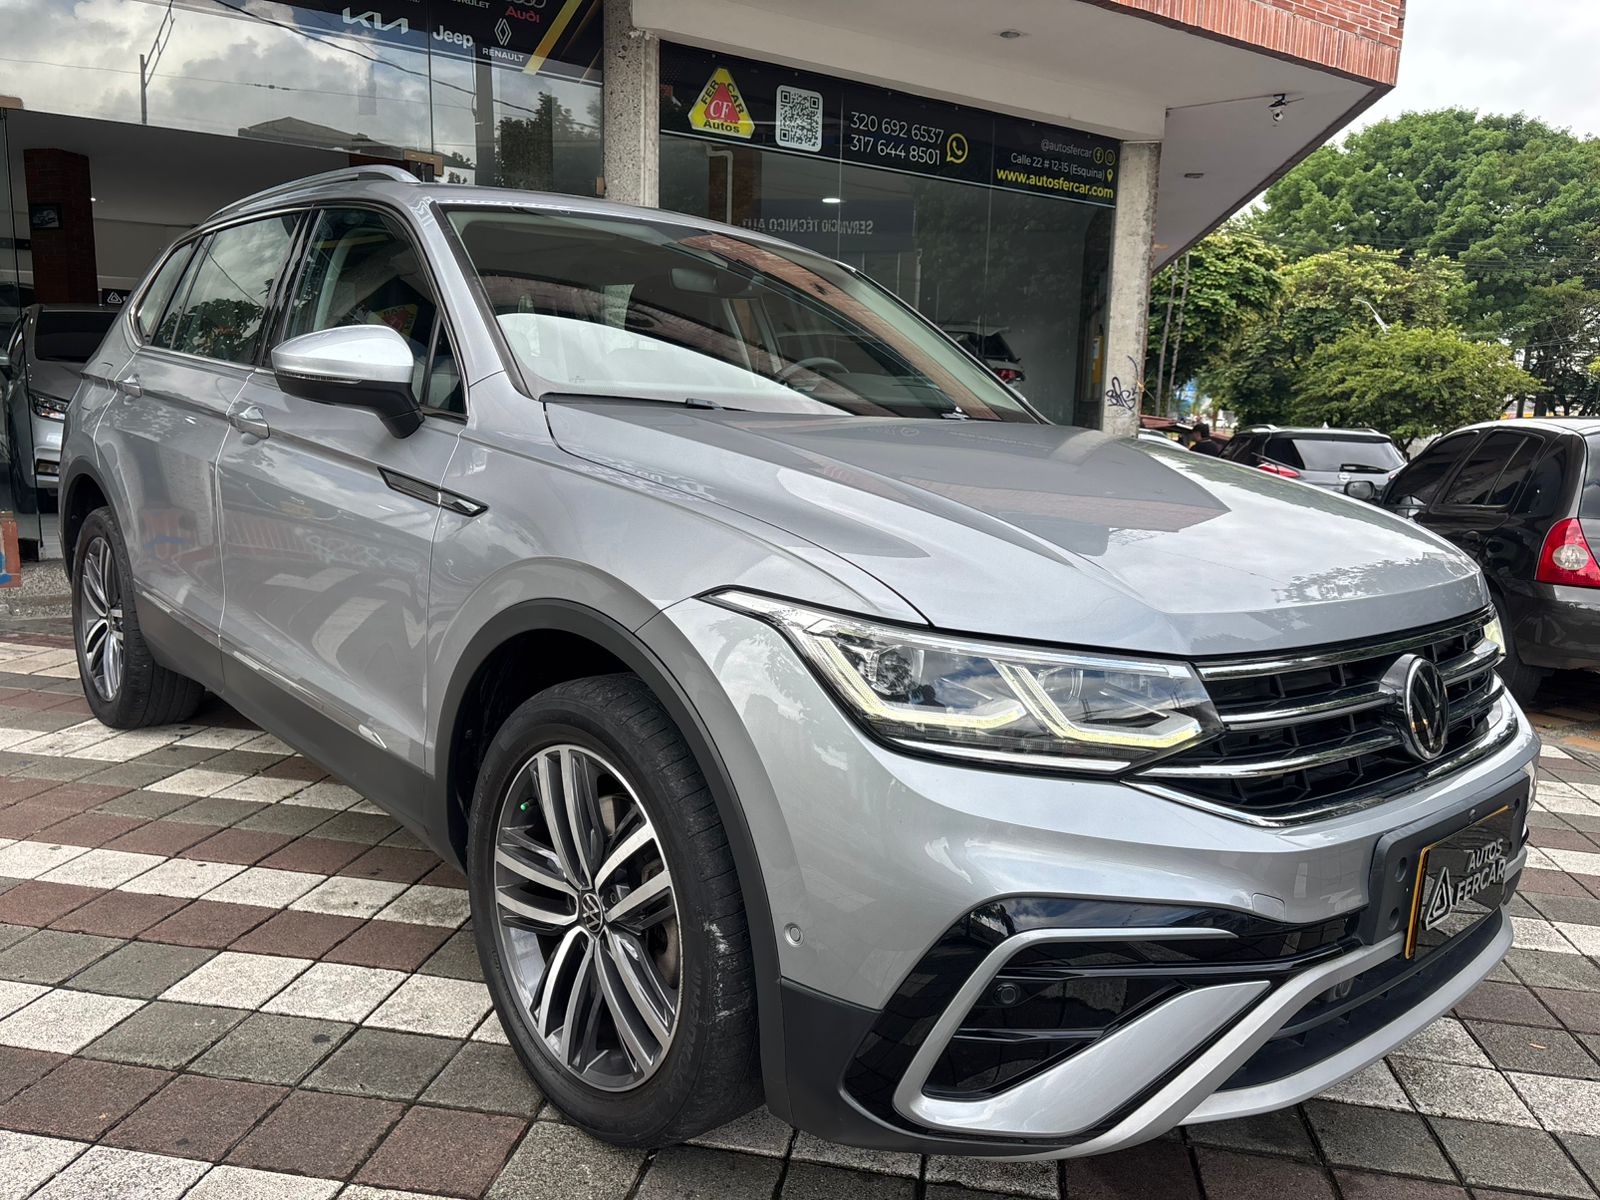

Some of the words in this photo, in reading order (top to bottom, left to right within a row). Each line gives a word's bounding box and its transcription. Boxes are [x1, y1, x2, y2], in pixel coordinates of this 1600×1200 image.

[343, 7, 408, 35] KIA
[505, 6, 541, 23] Audi
[433, 25, 474, 49] Jeep
[482, 47, 524, 62] RENAULT
[701, 80, 720, 105] FER
[726, 82, 744, 114] CAR
[710, 99, 732, 119] CF
[703, 120, 740, 134] Autos
[850, 111, 878, 132] 320
[882, 118, 908, 138] 692
[911, 124, 944, 144] 6537
[850, 134, 874, 153] 317
[877, 139, 906, 159] 644
[909, 145, 940, 165] 8501
[1041, 138, 1093, 158] @autosfercar
[1010, 152, 1031, 166] Calle
[1032, 157, 1043, 168] 22
[1044, 159, 1050, 168] #
[1051, 160, 1069, 172] 12-15
[1070, 164, 1105, 181] (Esquina)
[996, 168, 1114, 198] www.autosfercar.com
[1466, 838, 1504, 873] AUTOS
[1455, 858, 1506, 906] FERCAR
